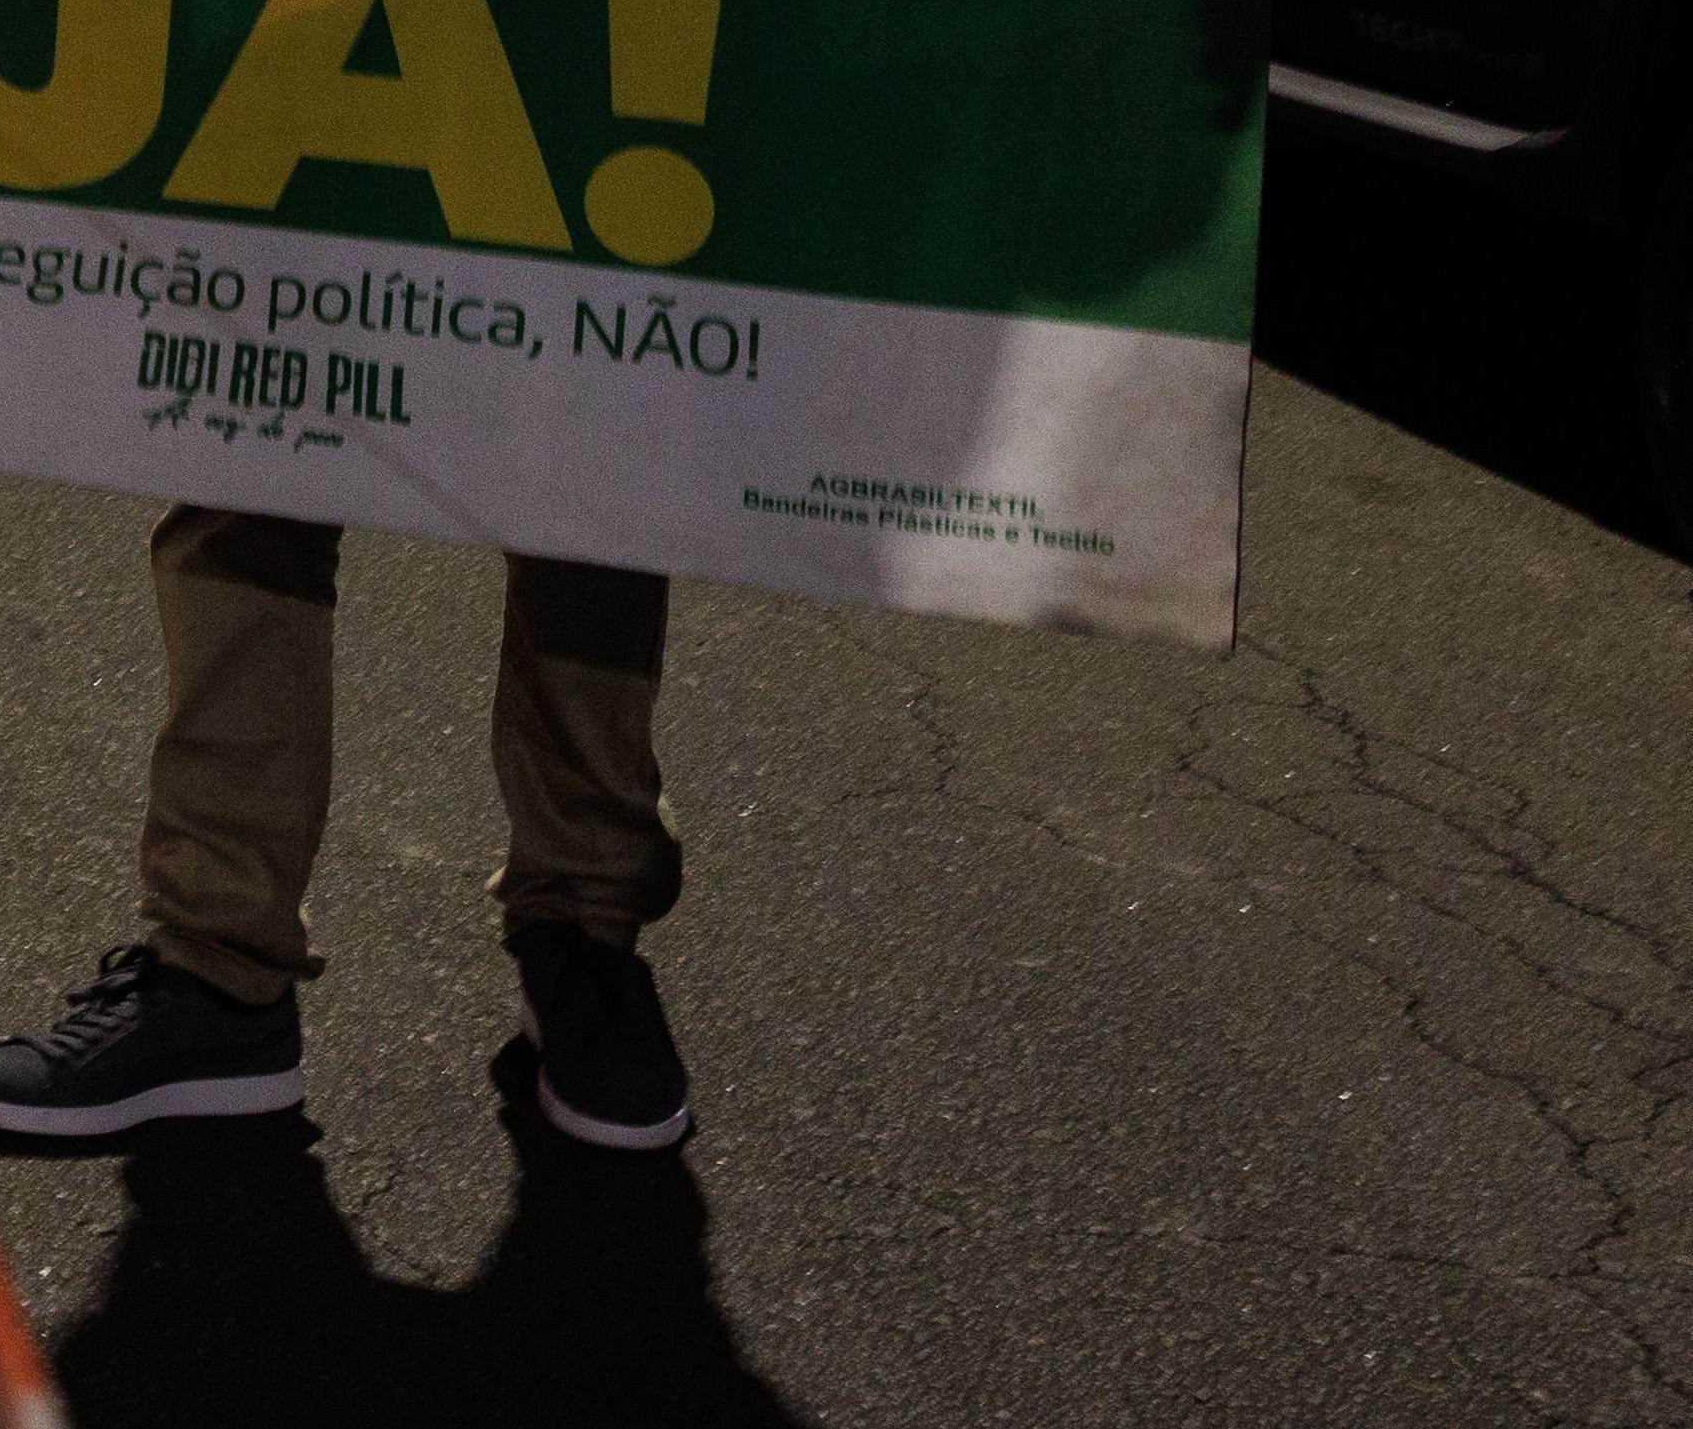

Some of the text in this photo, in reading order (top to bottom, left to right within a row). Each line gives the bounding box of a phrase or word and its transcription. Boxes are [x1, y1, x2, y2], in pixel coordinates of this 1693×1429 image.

[267, 272, 546, 361] política,
[572, 293, 762, 382] NÃO!
[136, 331, 221, 396] DIDI
[227, 341, 309, 409] RED
[325, 352, 412, 426] PILL
[742, 486, 870, 526] Bandeiras
